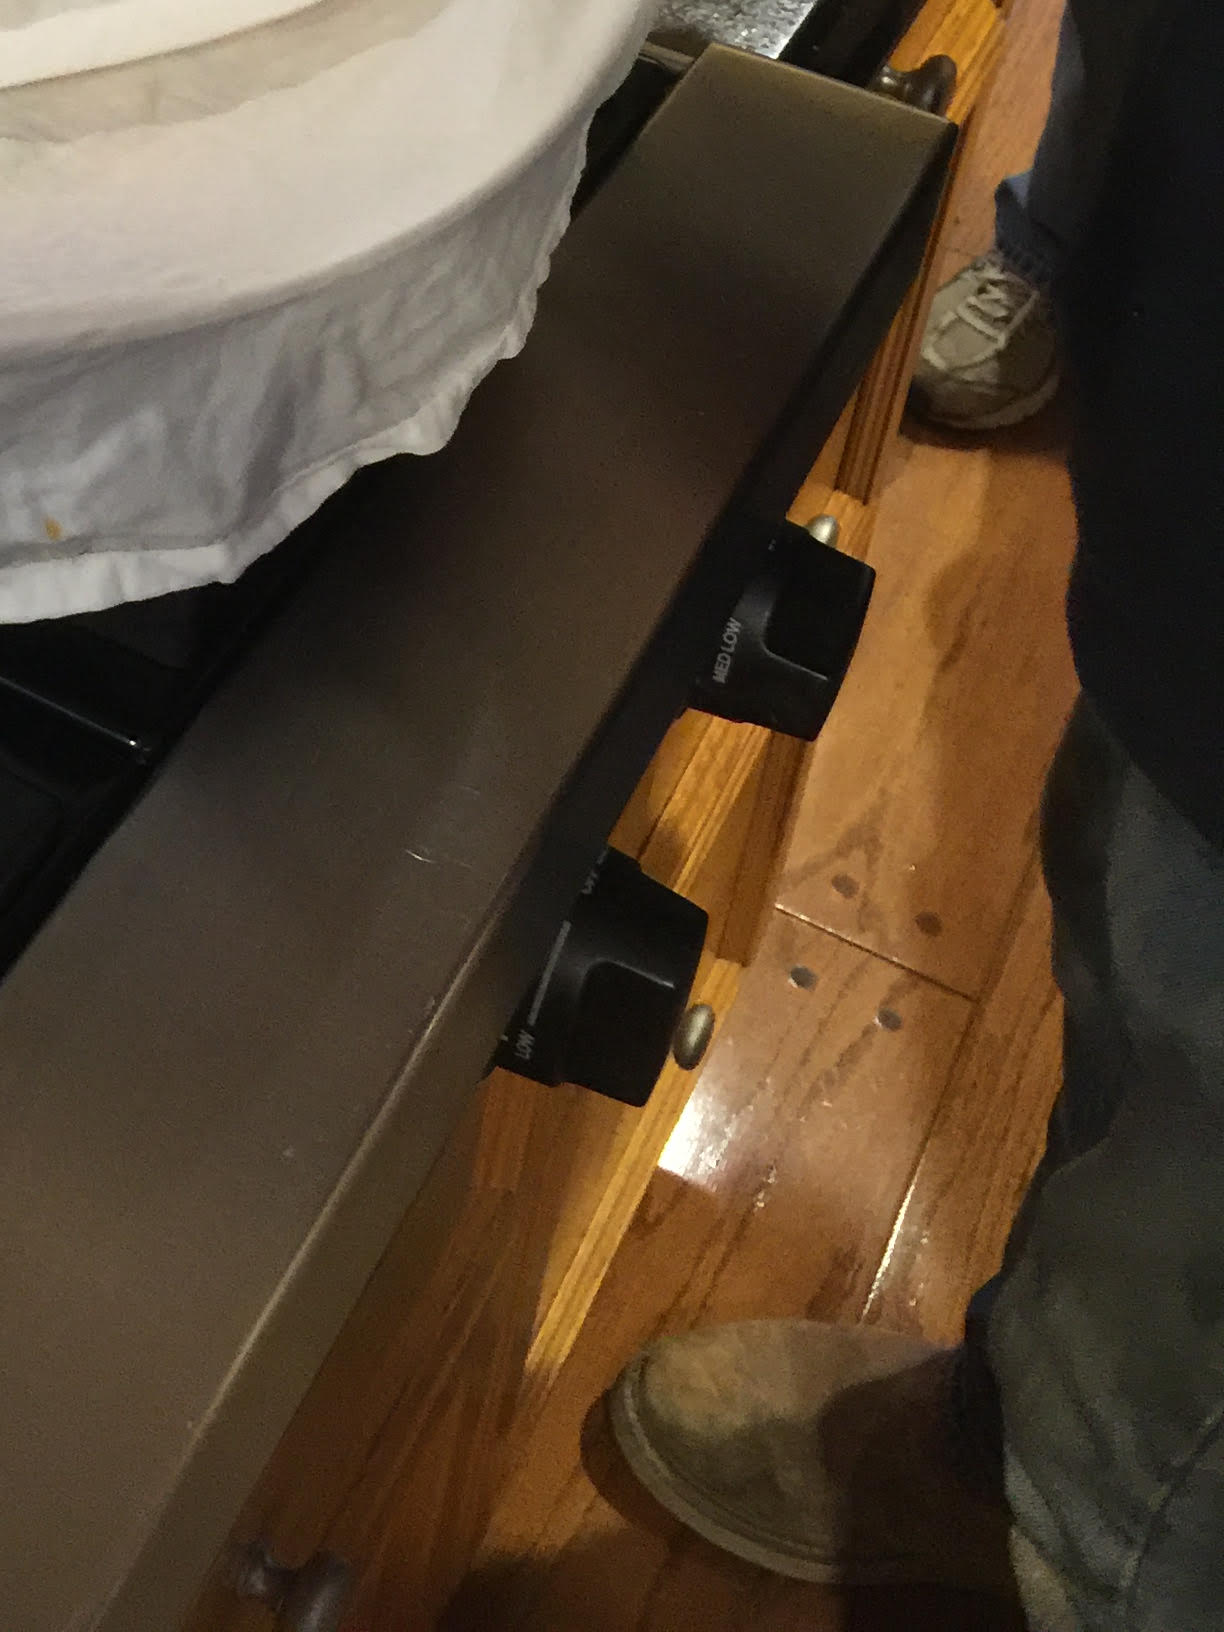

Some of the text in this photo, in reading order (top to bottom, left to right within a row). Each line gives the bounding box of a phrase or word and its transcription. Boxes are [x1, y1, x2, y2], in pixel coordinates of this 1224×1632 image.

[712, 617, 743, 684] MED LOW
[514, 1028, 535, 1061] LOW
